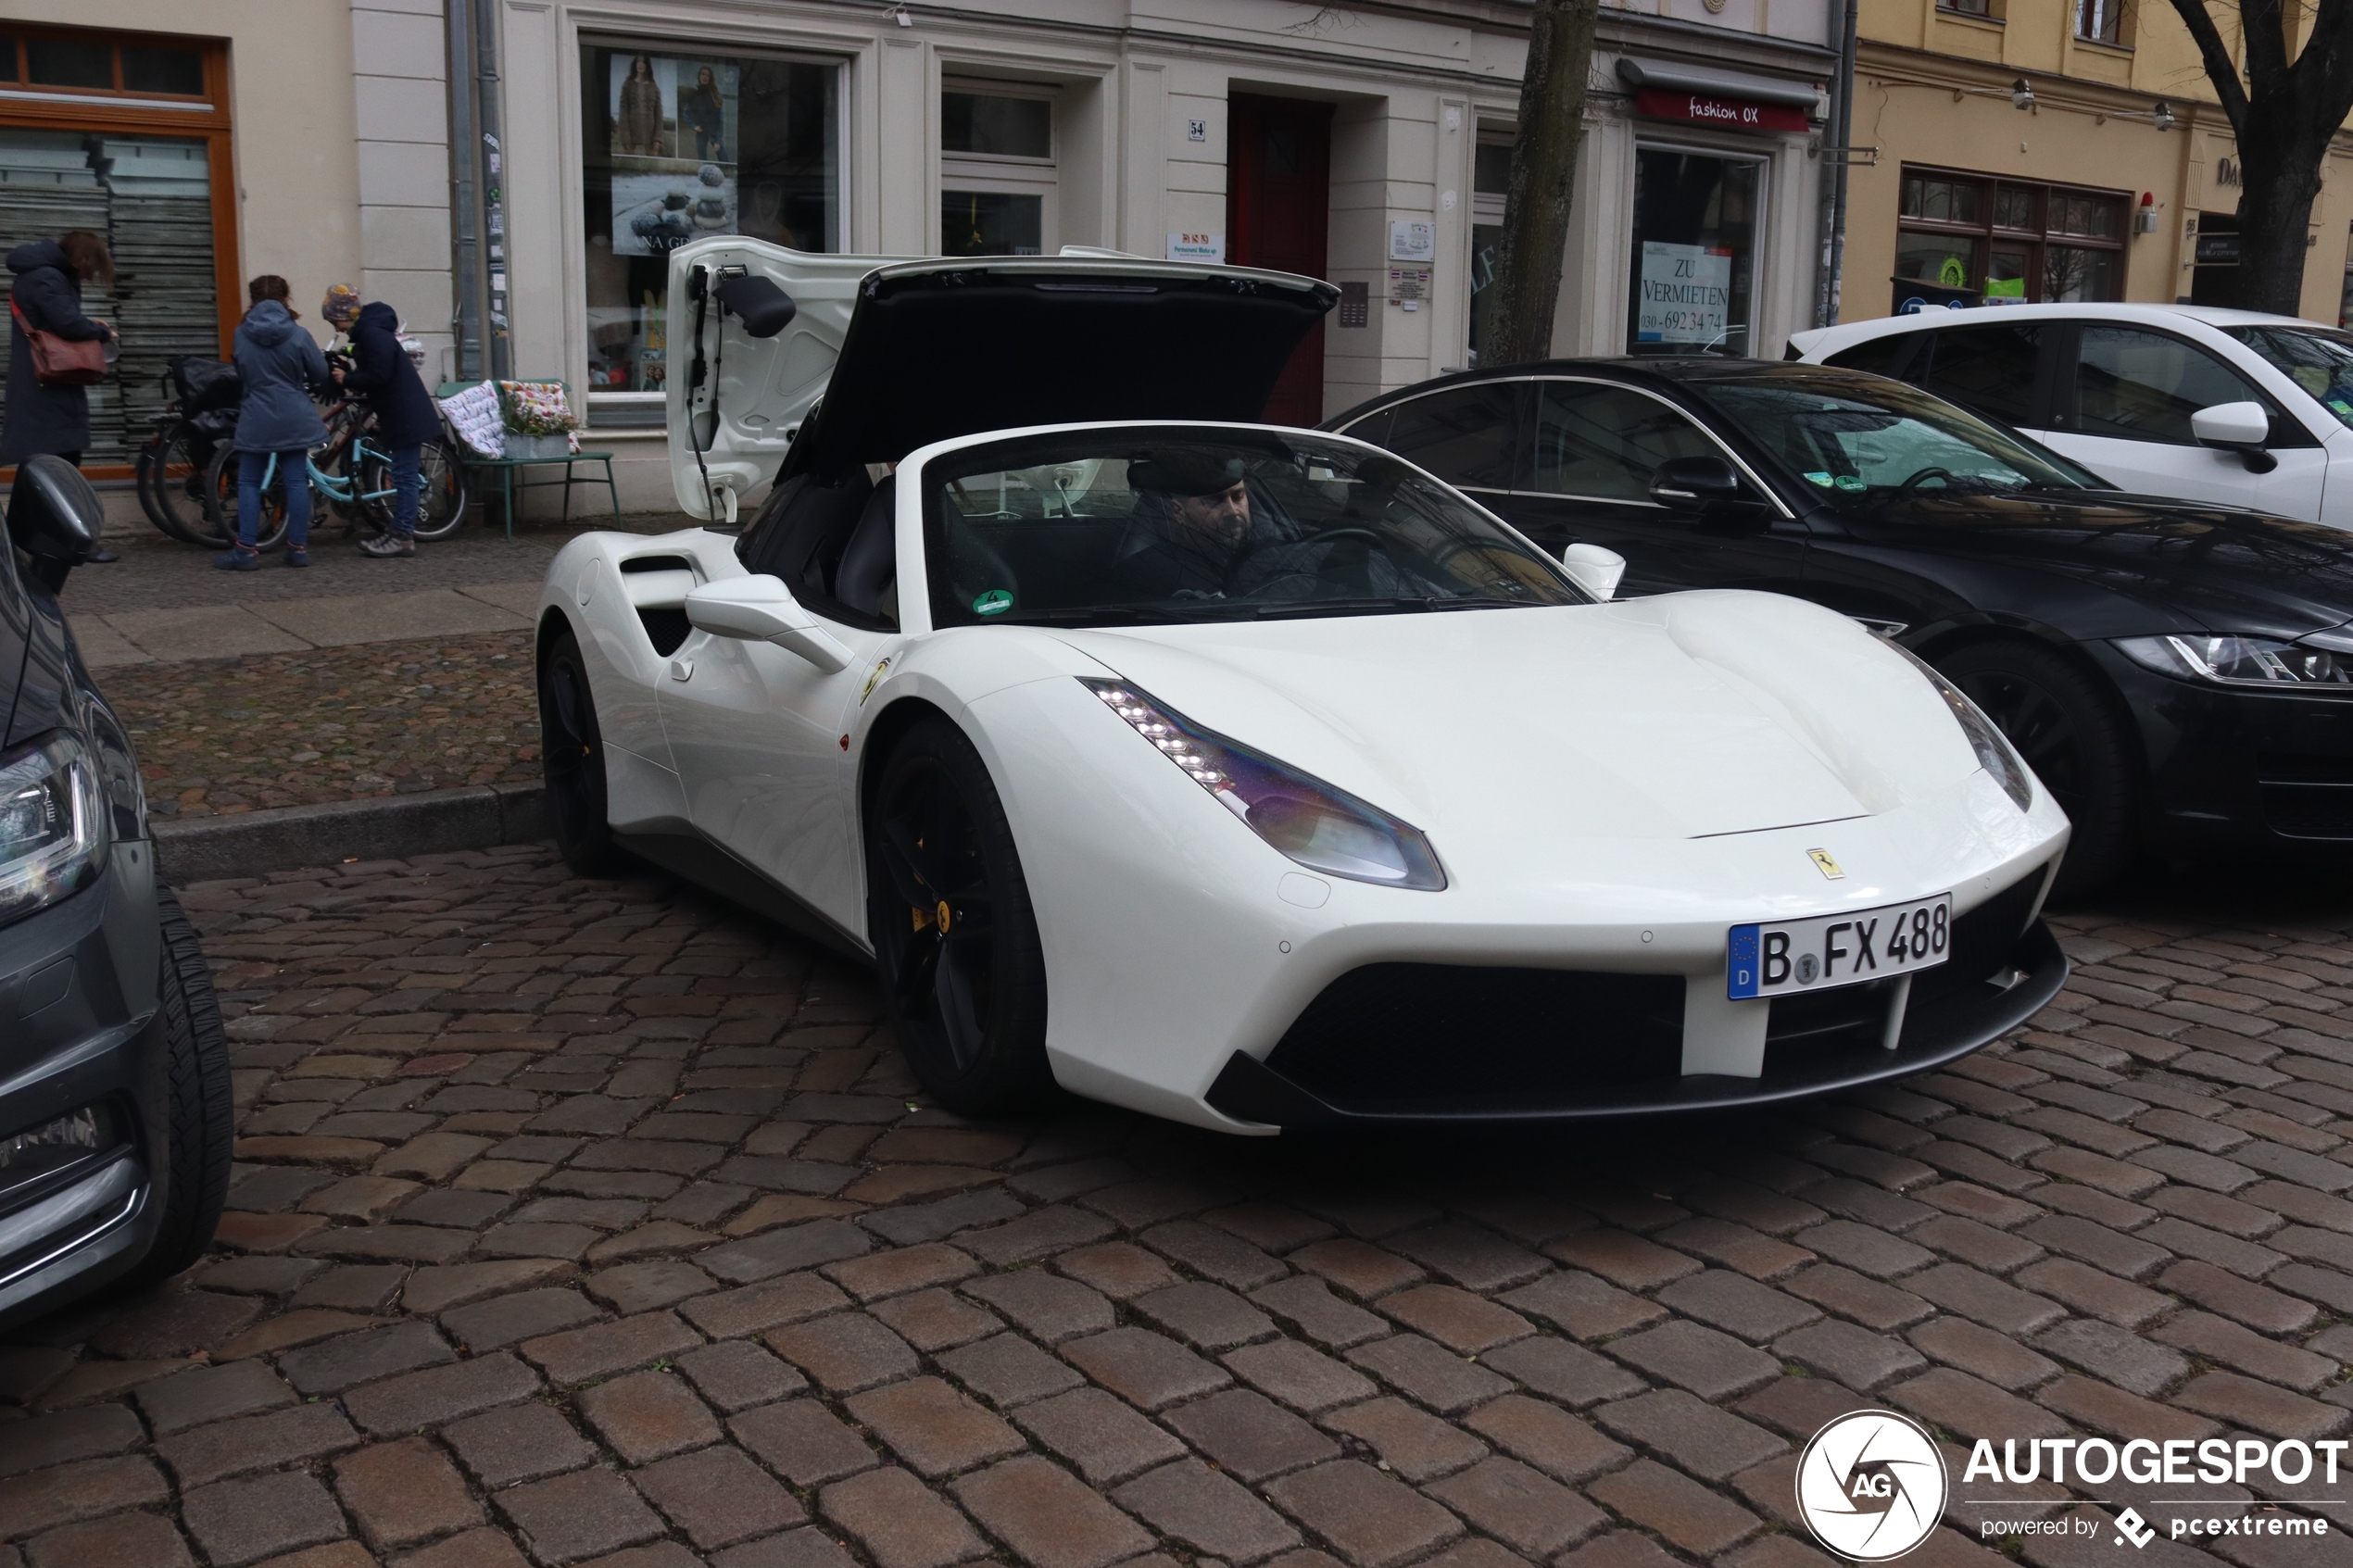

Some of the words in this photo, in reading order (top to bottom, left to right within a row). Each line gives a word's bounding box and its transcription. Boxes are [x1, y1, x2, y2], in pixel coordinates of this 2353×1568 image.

[1689, 96, 1738, 120] fashion
[1743, 107, 1758, 123] OX
[1191, 121, 1203, 135] 54
[1674, 258, 1696, 279] ZU
[1642, 280, 1728, 306] VERMIETEN
[1640, 315, 1656, 328] 030
[987, 590, 999, 602] 4
[1762, 931, 1792, 986] B
[1825, 917, 1878, 978] FX
[1888, 903, 1947, 963] 488
[1738, 970, 1750, 985] D
